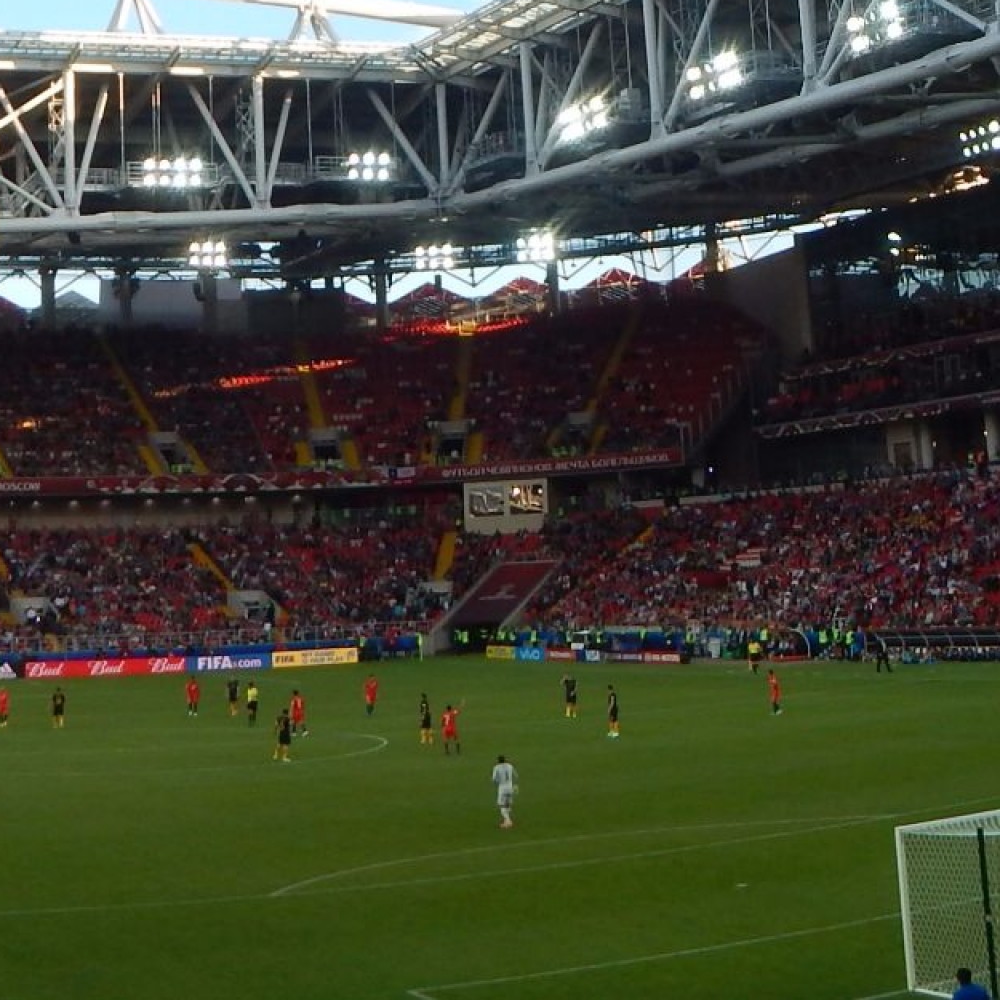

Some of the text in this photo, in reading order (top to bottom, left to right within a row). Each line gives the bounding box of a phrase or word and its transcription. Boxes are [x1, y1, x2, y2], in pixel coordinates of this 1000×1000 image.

[149, 657, 185, 673] Bud
[275, 655, 294, 664] FIFA
[25, 662, 65, 677] Bud
[88, 660, 125, 675] Bud
